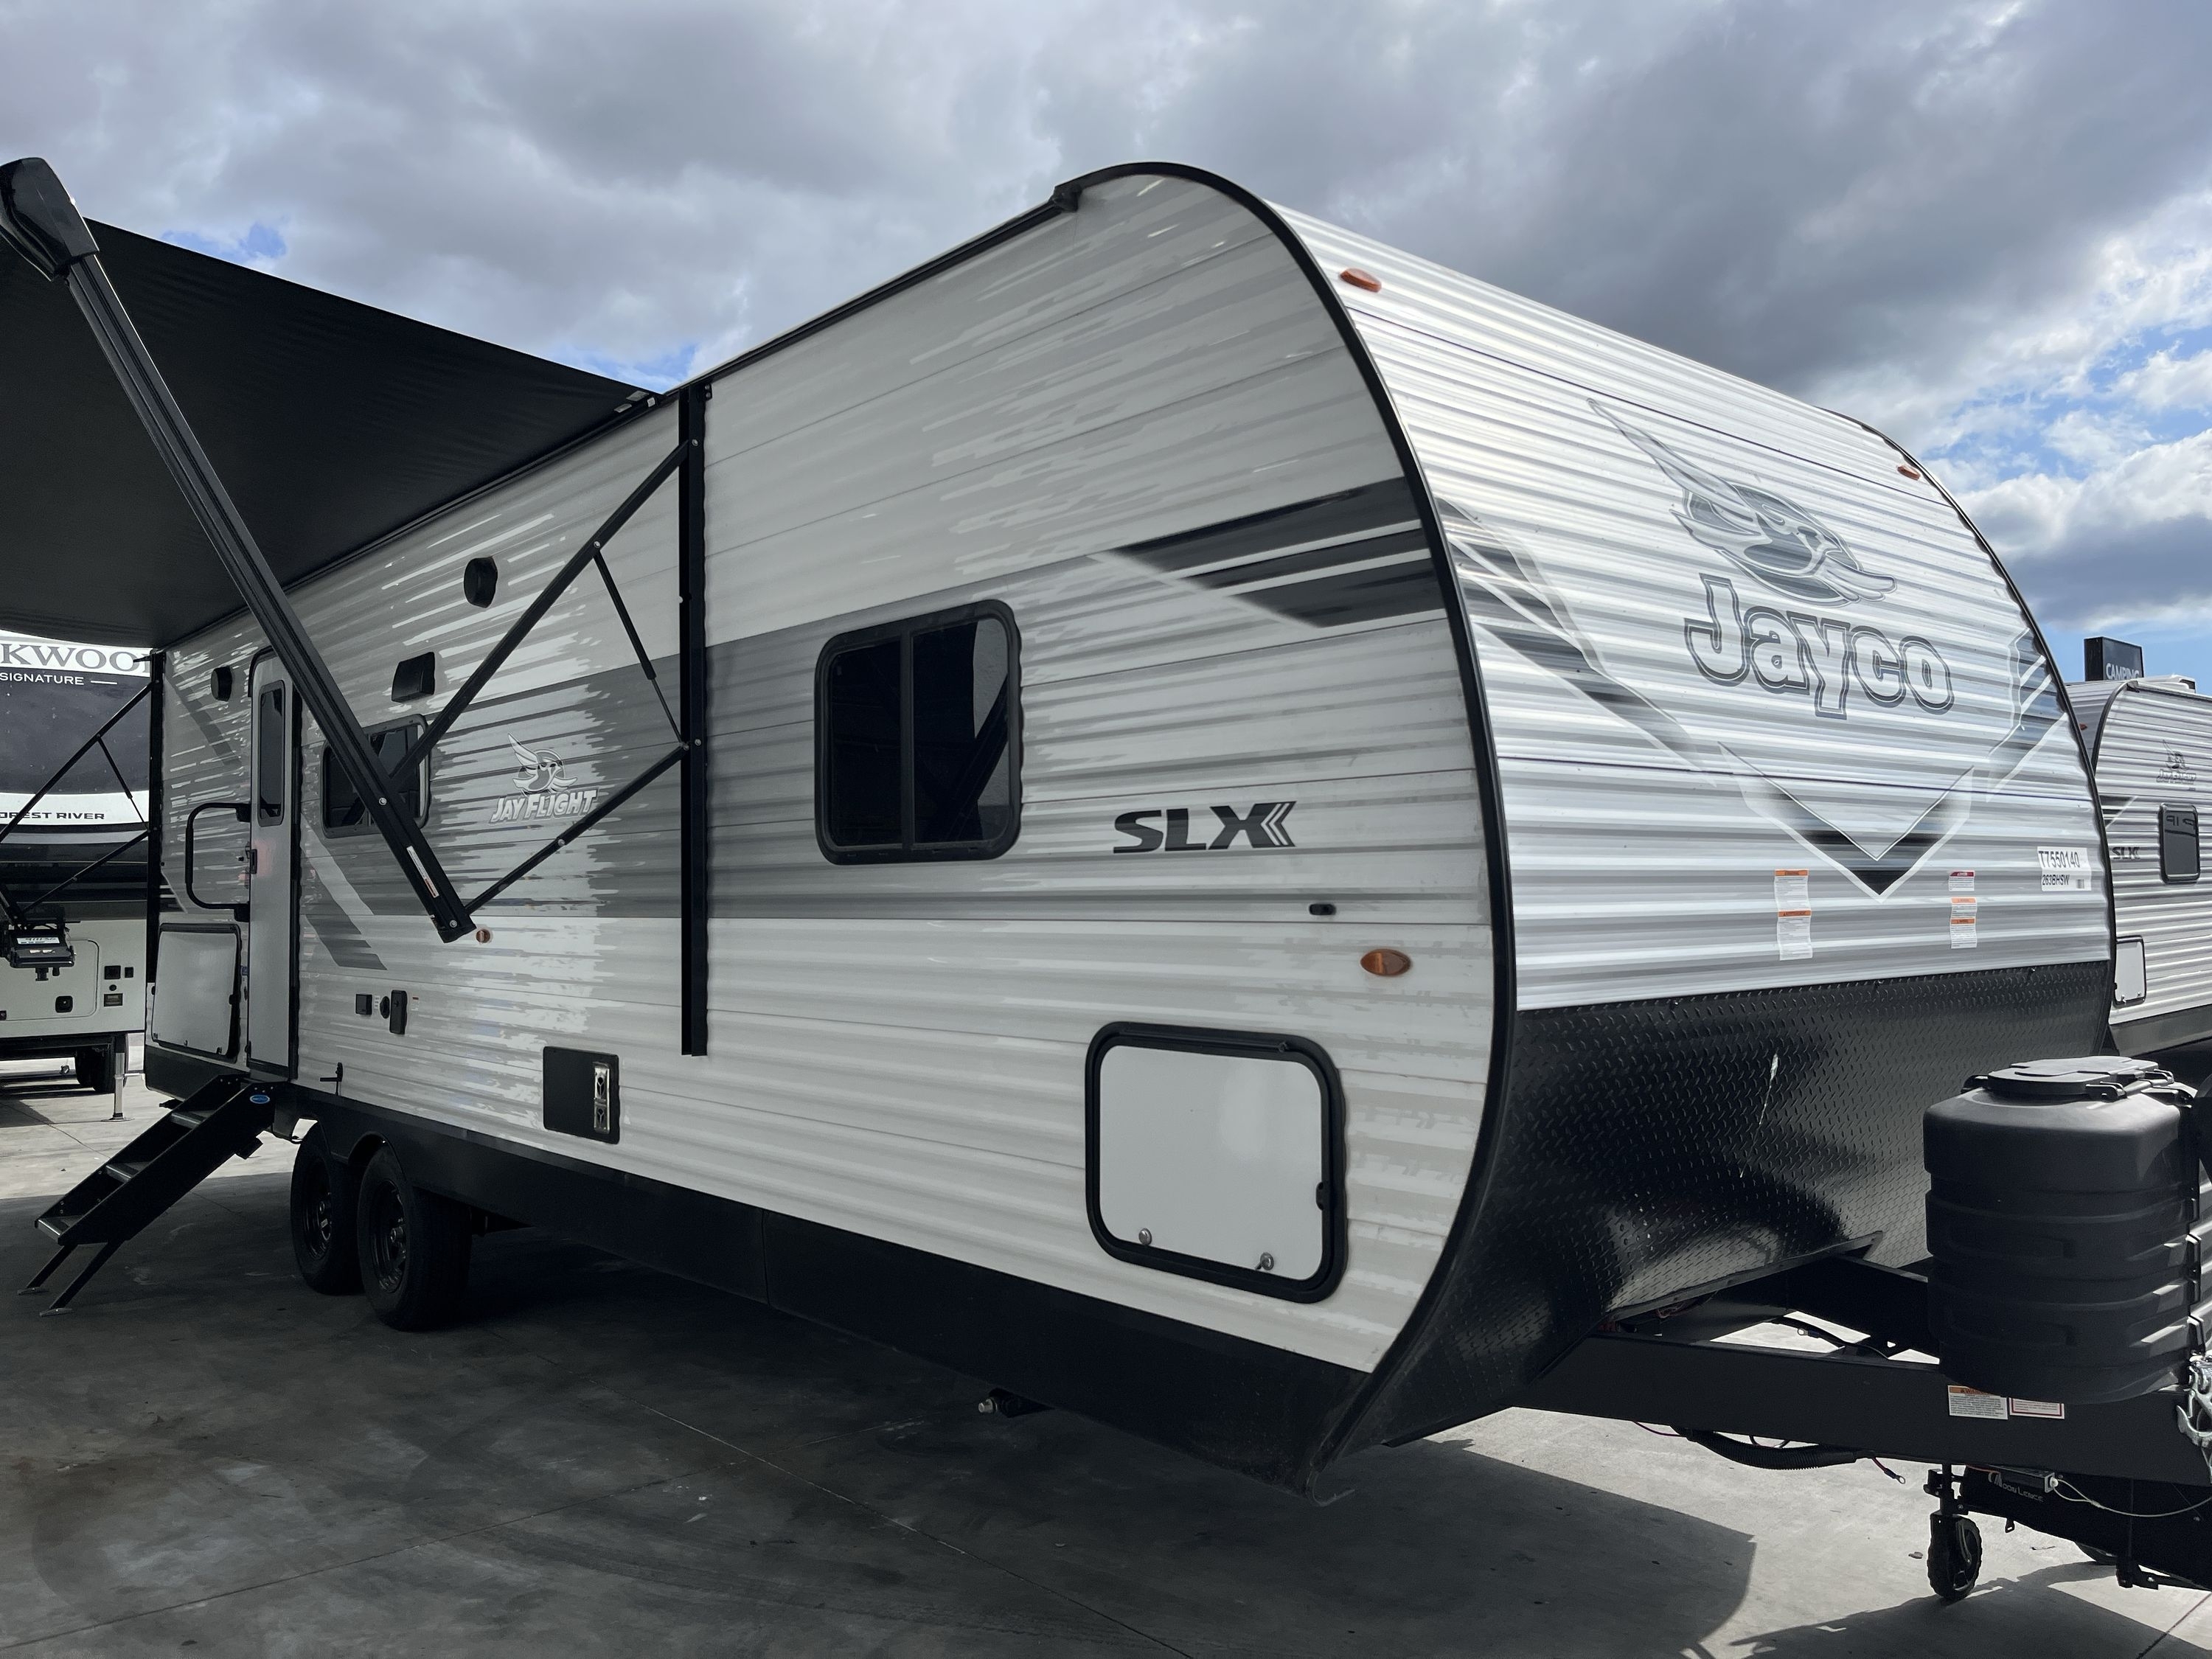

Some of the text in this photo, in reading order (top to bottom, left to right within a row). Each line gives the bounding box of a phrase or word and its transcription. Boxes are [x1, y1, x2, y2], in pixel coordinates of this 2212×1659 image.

[0, 643, 150, 674] KWOO
[1683, 573, 1955, 720] Jayco
[0, 672, 85, 686] SIGNATURE
[56, 812, 105, 820] RIVER
[1113, 801, 1297, 854] SLX
